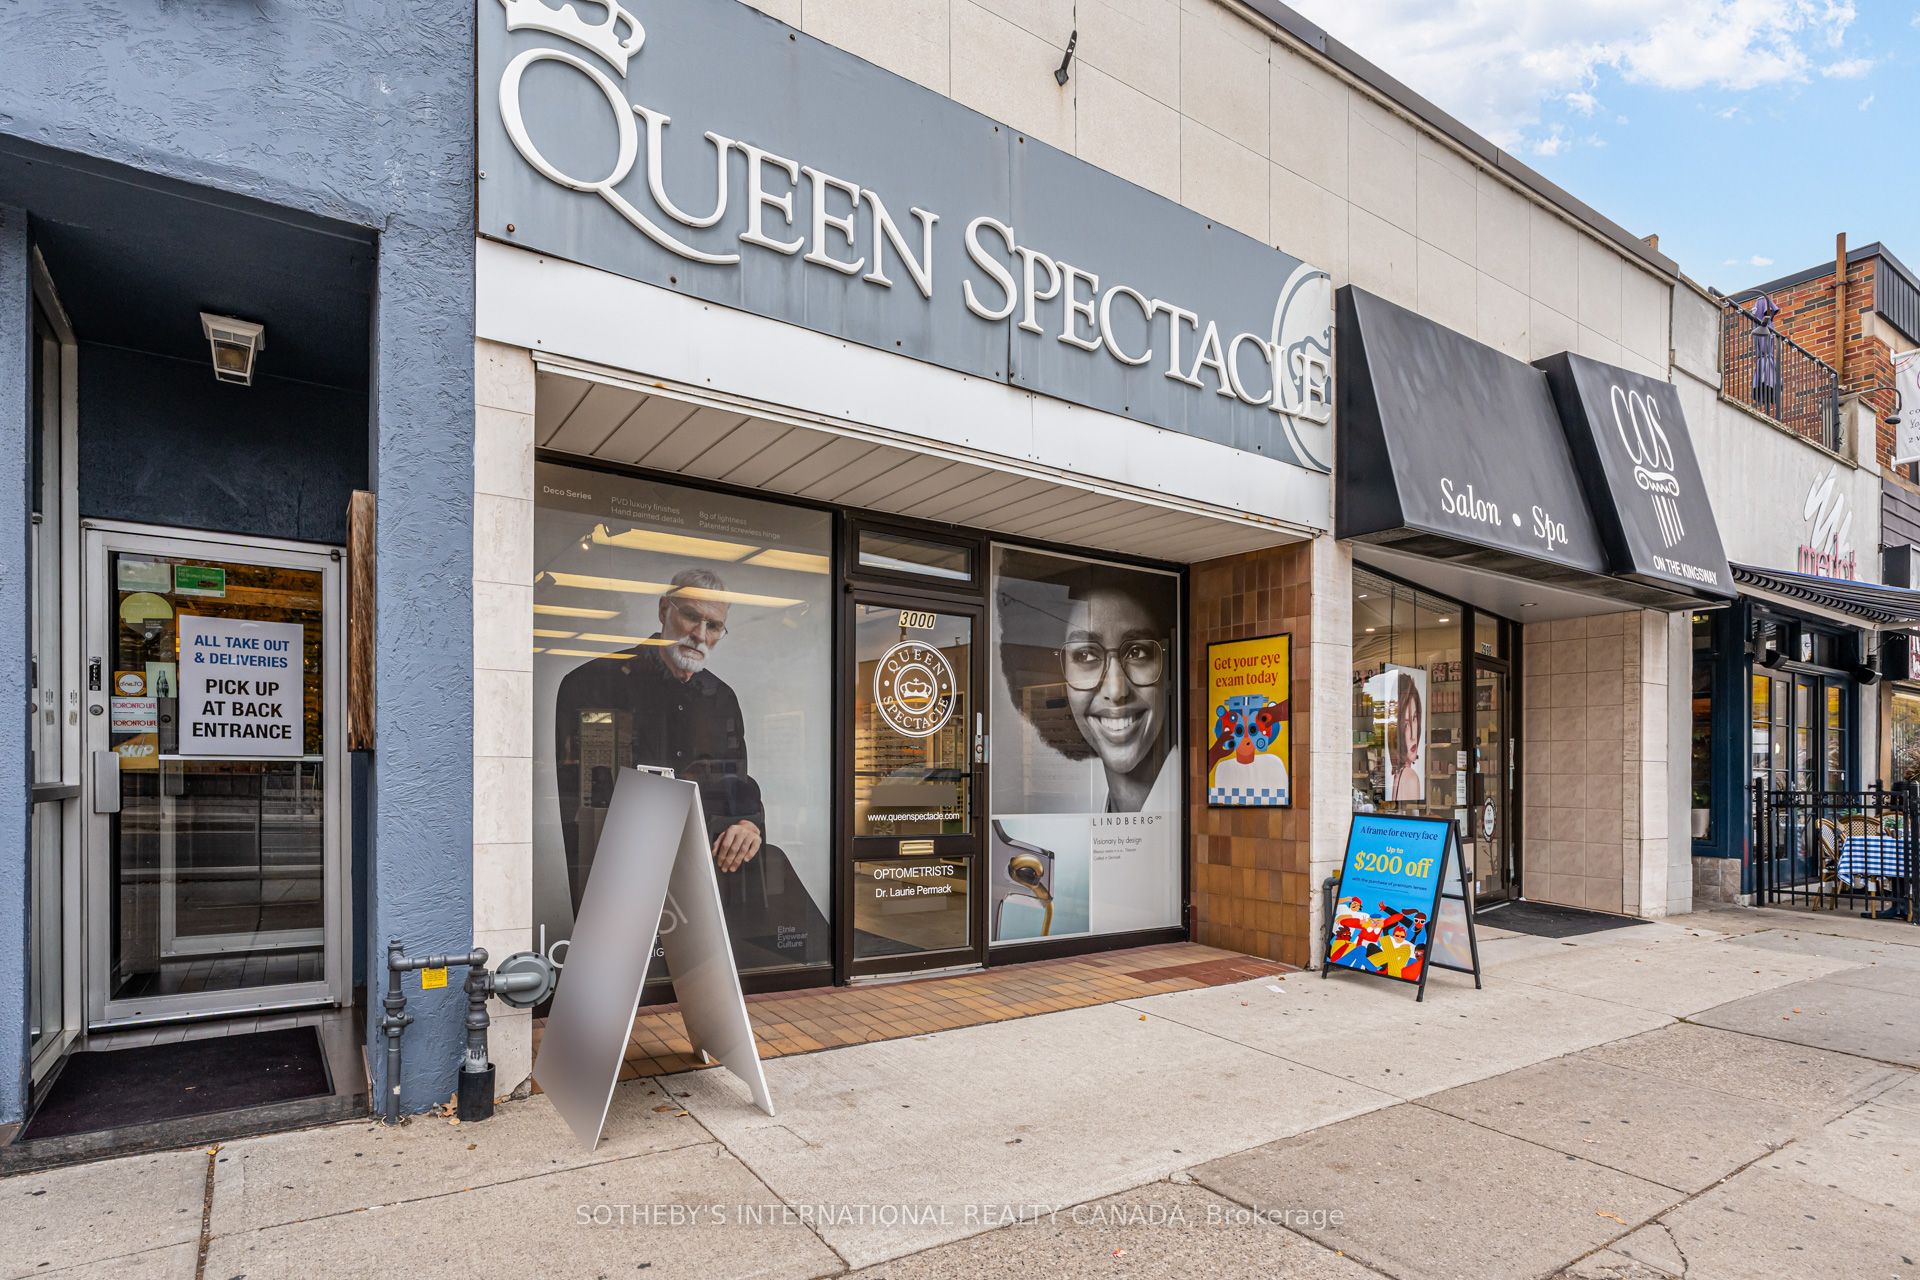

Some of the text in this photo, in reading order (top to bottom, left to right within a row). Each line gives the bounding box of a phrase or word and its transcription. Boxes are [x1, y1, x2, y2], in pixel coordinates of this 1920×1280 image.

[499, 47, 1331, 426] QUEEN SPECTACLE
[1610, 384, 1674, 472] COS
[543, 485, 592, 500] Deco Series
[611, 496, 680, 515] PVD luxury finishes
[1440, 477, 1568, 551] Salon Spa
[611, 506, 684, 525] Hand painted details
[717, 514, 747, 525] lightness
[699, 520, 780, 540] Patented screwless hinge
[1653, 555, 1718, 586] ON THE KINGSWAY
[900, 611, 935, 629] 3000
[194, 634, 290, 652] ALL TAKE OUT
[194, 652, 288, 668] & DELIVERIES
[887, 648, 945, 676] QUEEN
[1214, 652, 1281, 672] Get your eye
[205, 679, 279, 696] PICK UP
[1215, 670, 1279, 688] exam today
[202, 701, 283, 718] AT BACK
[883, 695, 949, 730] SPECTACLE
[192, 722, 292, 740] ENTRANCE
[867, 811, 960, 823] www.queenspectacle.com
[1092, 816, 1154, 827] LINDBERG
[1093, 836, 1142, 846] Visionary by design
[1360, 826, 1439, 841] A frame for every face
[1386, 846, 1396, 855] Up
[873, 865, 954, 880] OPTOMETRISTS
[1353, 850, 1435, 878] $200 off
[875, 884, 952, 898] Dr. Laurie Permack
